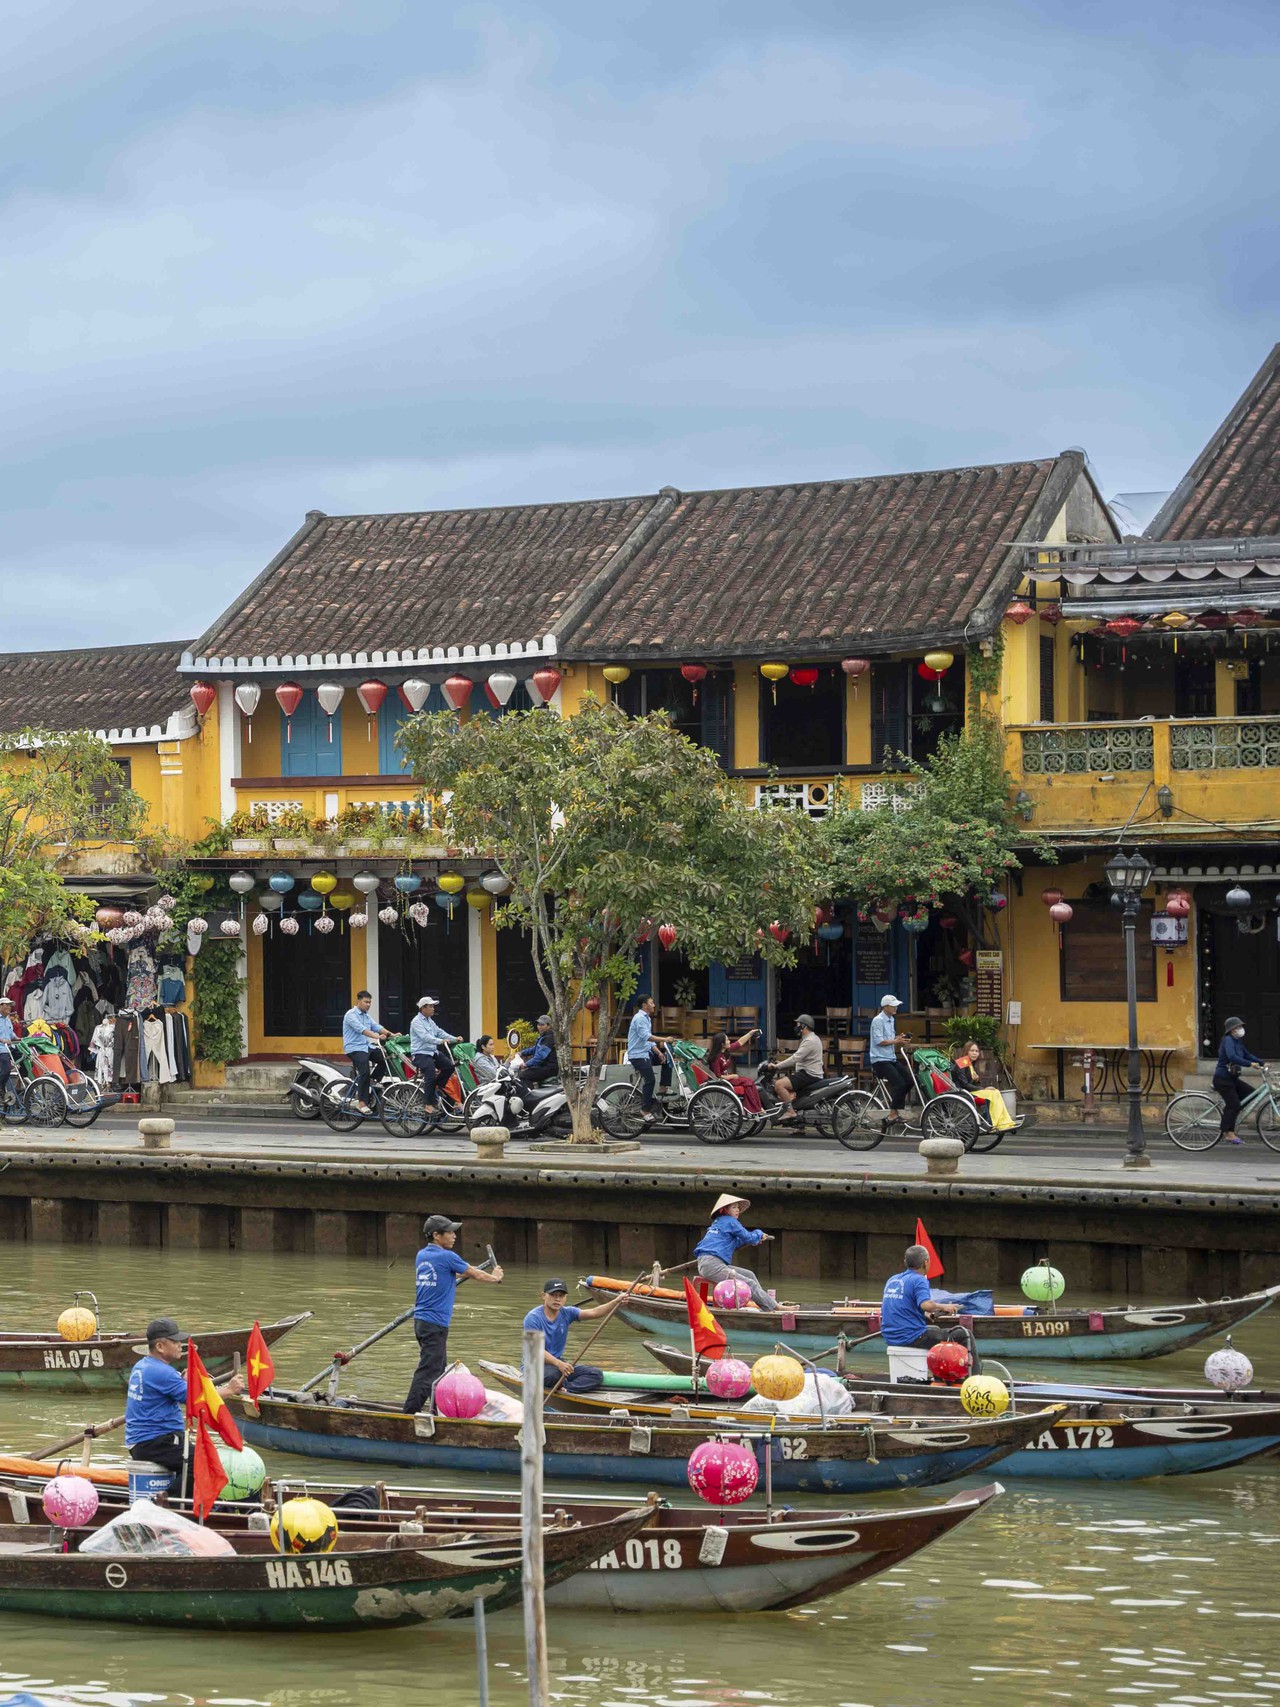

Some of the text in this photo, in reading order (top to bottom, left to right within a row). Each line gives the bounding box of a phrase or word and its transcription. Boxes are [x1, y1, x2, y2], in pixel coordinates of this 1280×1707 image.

[43, 1348, 105, 1369] HA.079
[585, 1539, 683, 1569] A.018
[265, 1560, 353, 1588] HA.146
